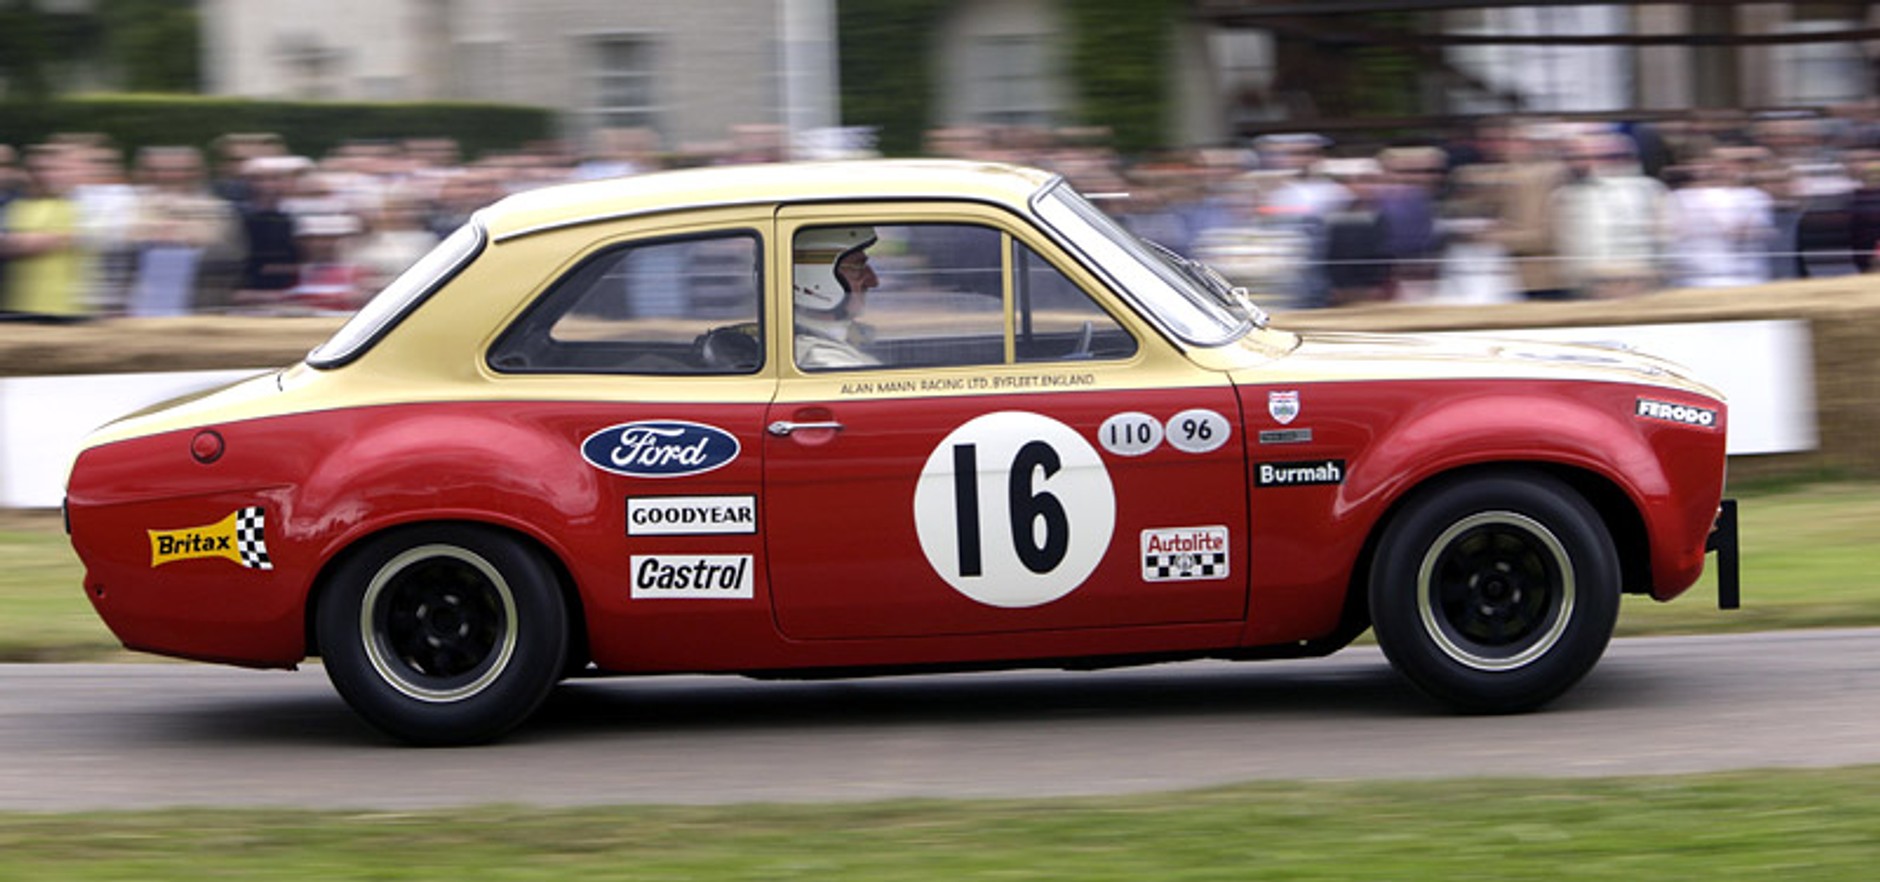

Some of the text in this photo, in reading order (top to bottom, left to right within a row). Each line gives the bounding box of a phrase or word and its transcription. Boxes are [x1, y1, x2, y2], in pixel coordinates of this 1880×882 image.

[841, 383, 873, 394] ALAN
[877, 380, 916, 392] MANN
[920, 378, 964, 390] RACING
[1640, 401, 1713, 425] FERODO
[1111, 423, 1151, 445] 110
[1182, 419, 1212, 440] 96
[611, 427, 709, 466] Ford
[1260, 462, 1340, 483] Burmah
[632, 507, 752, 525] GOODYEAR
[953, 440, 1070, 577] 16
[157, 533, 231, 555] Britax
[1148, 532, 1223, 553] Autolite
[637, 557, 747, 589] Castrol
